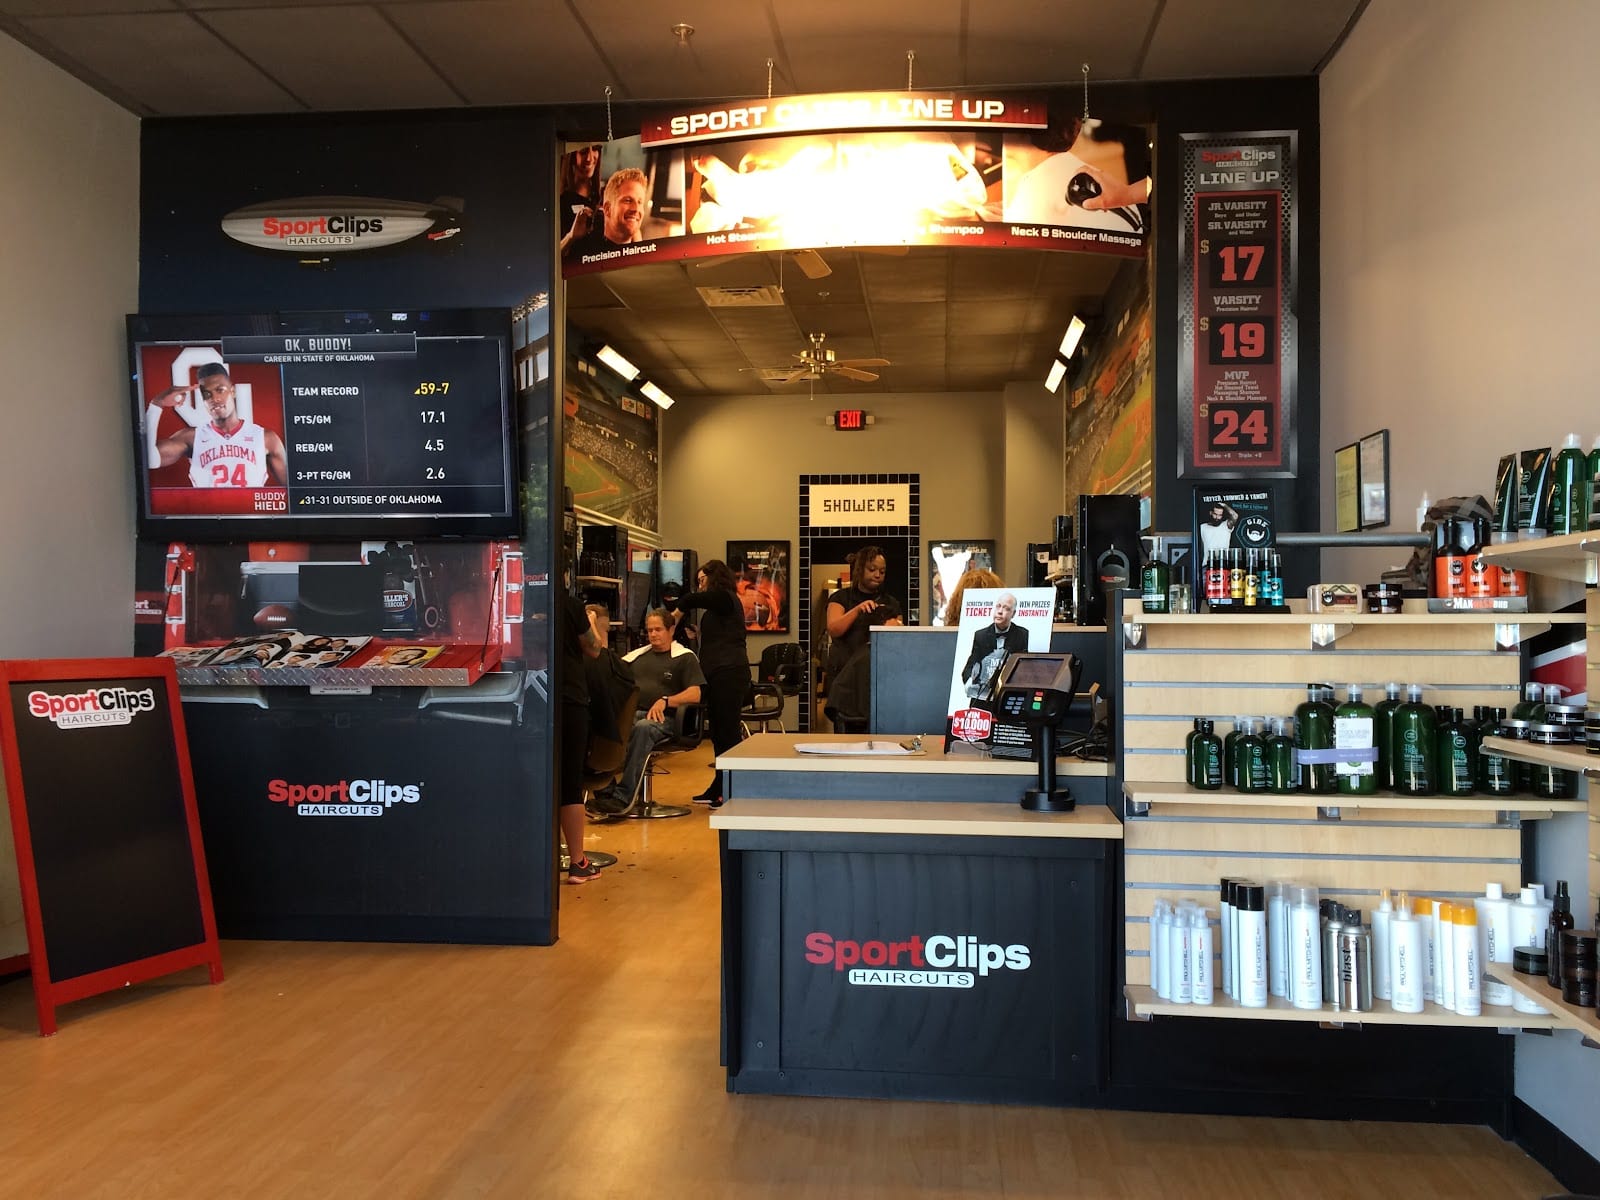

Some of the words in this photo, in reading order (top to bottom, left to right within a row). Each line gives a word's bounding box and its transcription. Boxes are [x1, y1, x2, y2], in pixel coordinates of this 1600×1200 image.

[670, 106, 767, 136] SPORT
[879, 98, 954, 121] LINE
[961, 100, 1004, 120] UP
[1201, 149, 1276, 162] SportClips
[1200, 172, 1246, 185] LINE
[1251, 170, 1280, 183] UP
[1207, 202, 1223, 211] JR.
[1223, 201, 1267, 211] VARSITY
[263, 216, 384, 238] SportClips
[929, 225, 984, 237] Shampoo
[1207, 221, 1223, 230] SR.
[1223, 220, 1268, 230] VARSITY
[289, 236, 352, 245] HAIRCUTS
[706, 235, 726, 245] Hot
[1011, 226, 1040, 238] Neck
[1041, 228, 1050, 237] &
[1051, 229, 1097, 242] Shoulder
[1099, 233, 1142, 247] Massage
[582, 249, 621, 264] Precision
[622, 243, 657, 257] Haircut
[1200, 240, 1210, 254] $
[1219, 246, 1265, 281] 17
[1213, 295, 1262, 305] VARSITY
[1200, 317, 1209, 331] $
[1219, 323, 1265, 358] 19
[284, 338, 305, 352] OK,
[308, 337, 352, 351] BUDDY!
[263, 355, 292, 363] CAREER
[324, 354, 335, 362] OF
[335, 354, 375, 362] OKLAHOMA
[1224, 371, 1250, 380] MVP
[292, 387, 319, 396] TEAM
[320, 386, 359, 396] RECORD
[420, 382, 450, 395] 59-7
[293, 415, 332, 425] PTS/GM
[420, 411, 446, 424] 17.1
[839, 410, 862, 428] EXIT
[1200, 403, 1209, 418] $
[1213, 410, 1268, 445] 24
[295, 443, 334, 453] REB/GM
[424, 439, 444, 452] 4.5
[199, 444, 257, 468] OKLAHOMA
[211, 463, 248, 488] 24
[296, 471, 319, 480] 3-PT
[320, 471, 351, 481] FG/GM
[425, 467, 446, 480] 2.6
[254, 492, 286, 500] BUDDY
[304, 495, 331, 505] 31-31
[332, 495, 373, 504] OUTSIDE
[374, 495, 387, 504] OF
[389, 494, 443, 504] OKLAHOMA
[254, 501, 287, 511] HIELD
[823, 498, 895, 513] SHOWERS
[384, 594, 409, 602] ILLER'S
[1031, 600, 1051, 608] PRIZES
[965, 607, 993, 617] TICKET
[1018, 609, 1049, 617] INSTANTLY
[30, 689, 153, 718] SportClips
[61, 712, 127, 725] HAIRCUTS
[964, 710, 981, 719] WIN
[268, 779, 420, 807] SportClips
[300, 806, 380, 815] HAIRCUTS
[804, 932, 1031, 977] SportClips
[853, 971, 970, 986] HAIRCUTS
